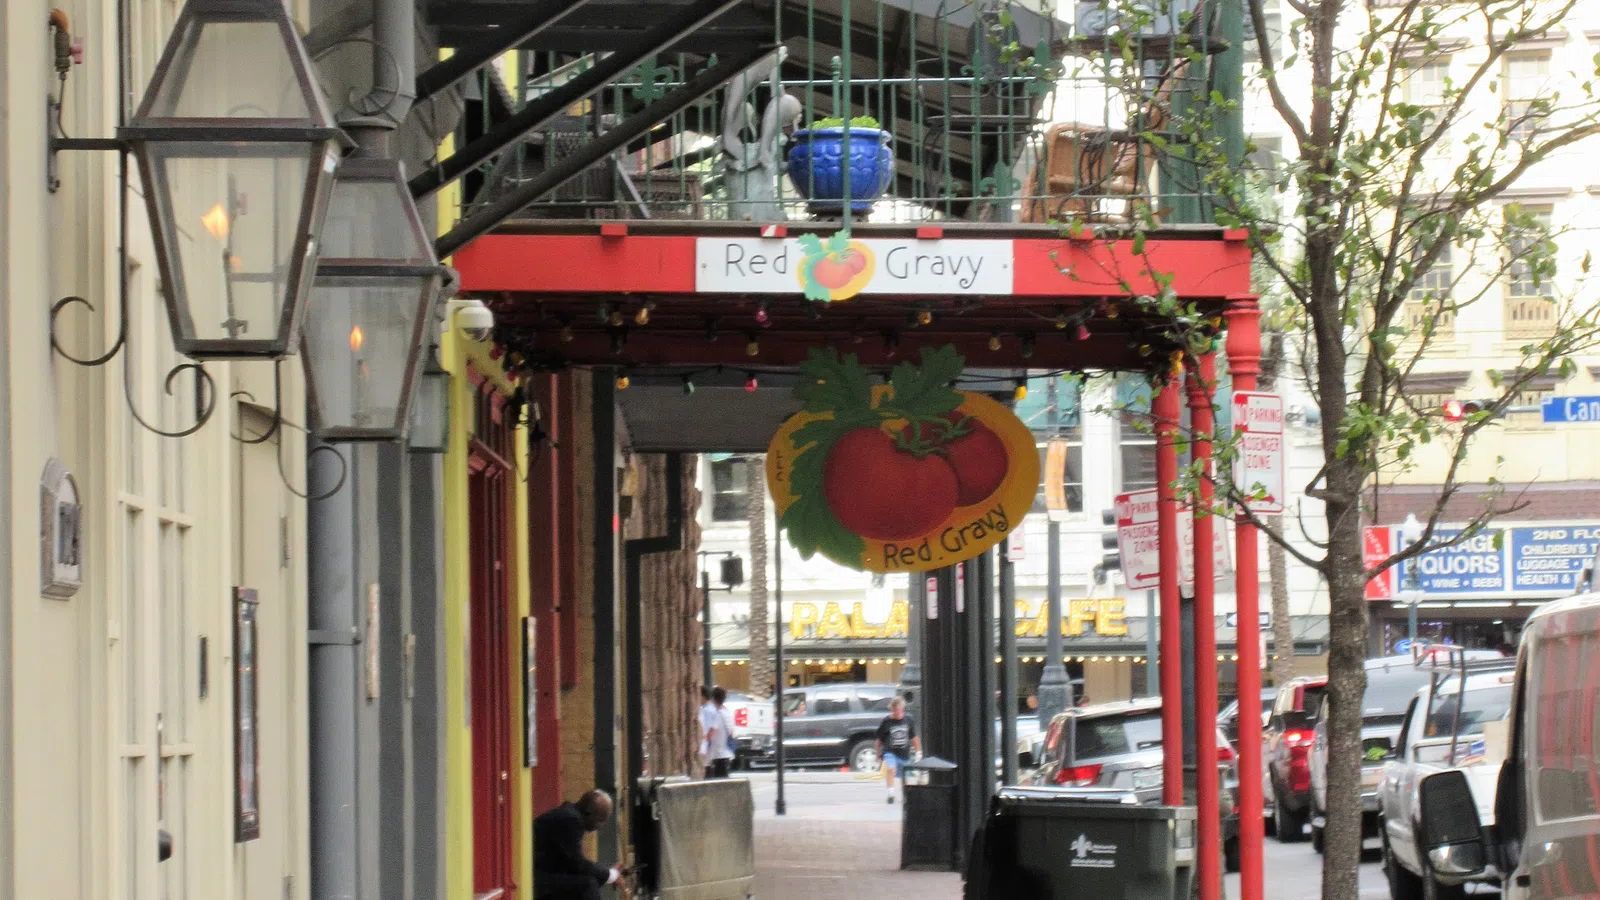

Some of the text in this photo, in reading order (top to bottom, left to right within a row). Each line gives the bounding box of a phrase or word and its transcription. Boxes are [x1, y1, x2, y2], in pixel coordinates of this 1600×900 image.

[725, 243, 984, 290] Red Gravy
[883, 537, 932, 569] Red
[941, 503, 1009, 553] Gravy
[1532, 530, 1568, 541] 2ND
[1401, 535, 1503, 554] CKAG
[1516, 559, 1570, 571] LUGGAGE
[1472, 577, 1503, 589] BEER
[1516, 574, 1559, 586] HEALTH
[789, 601, 910, 639] PALA
